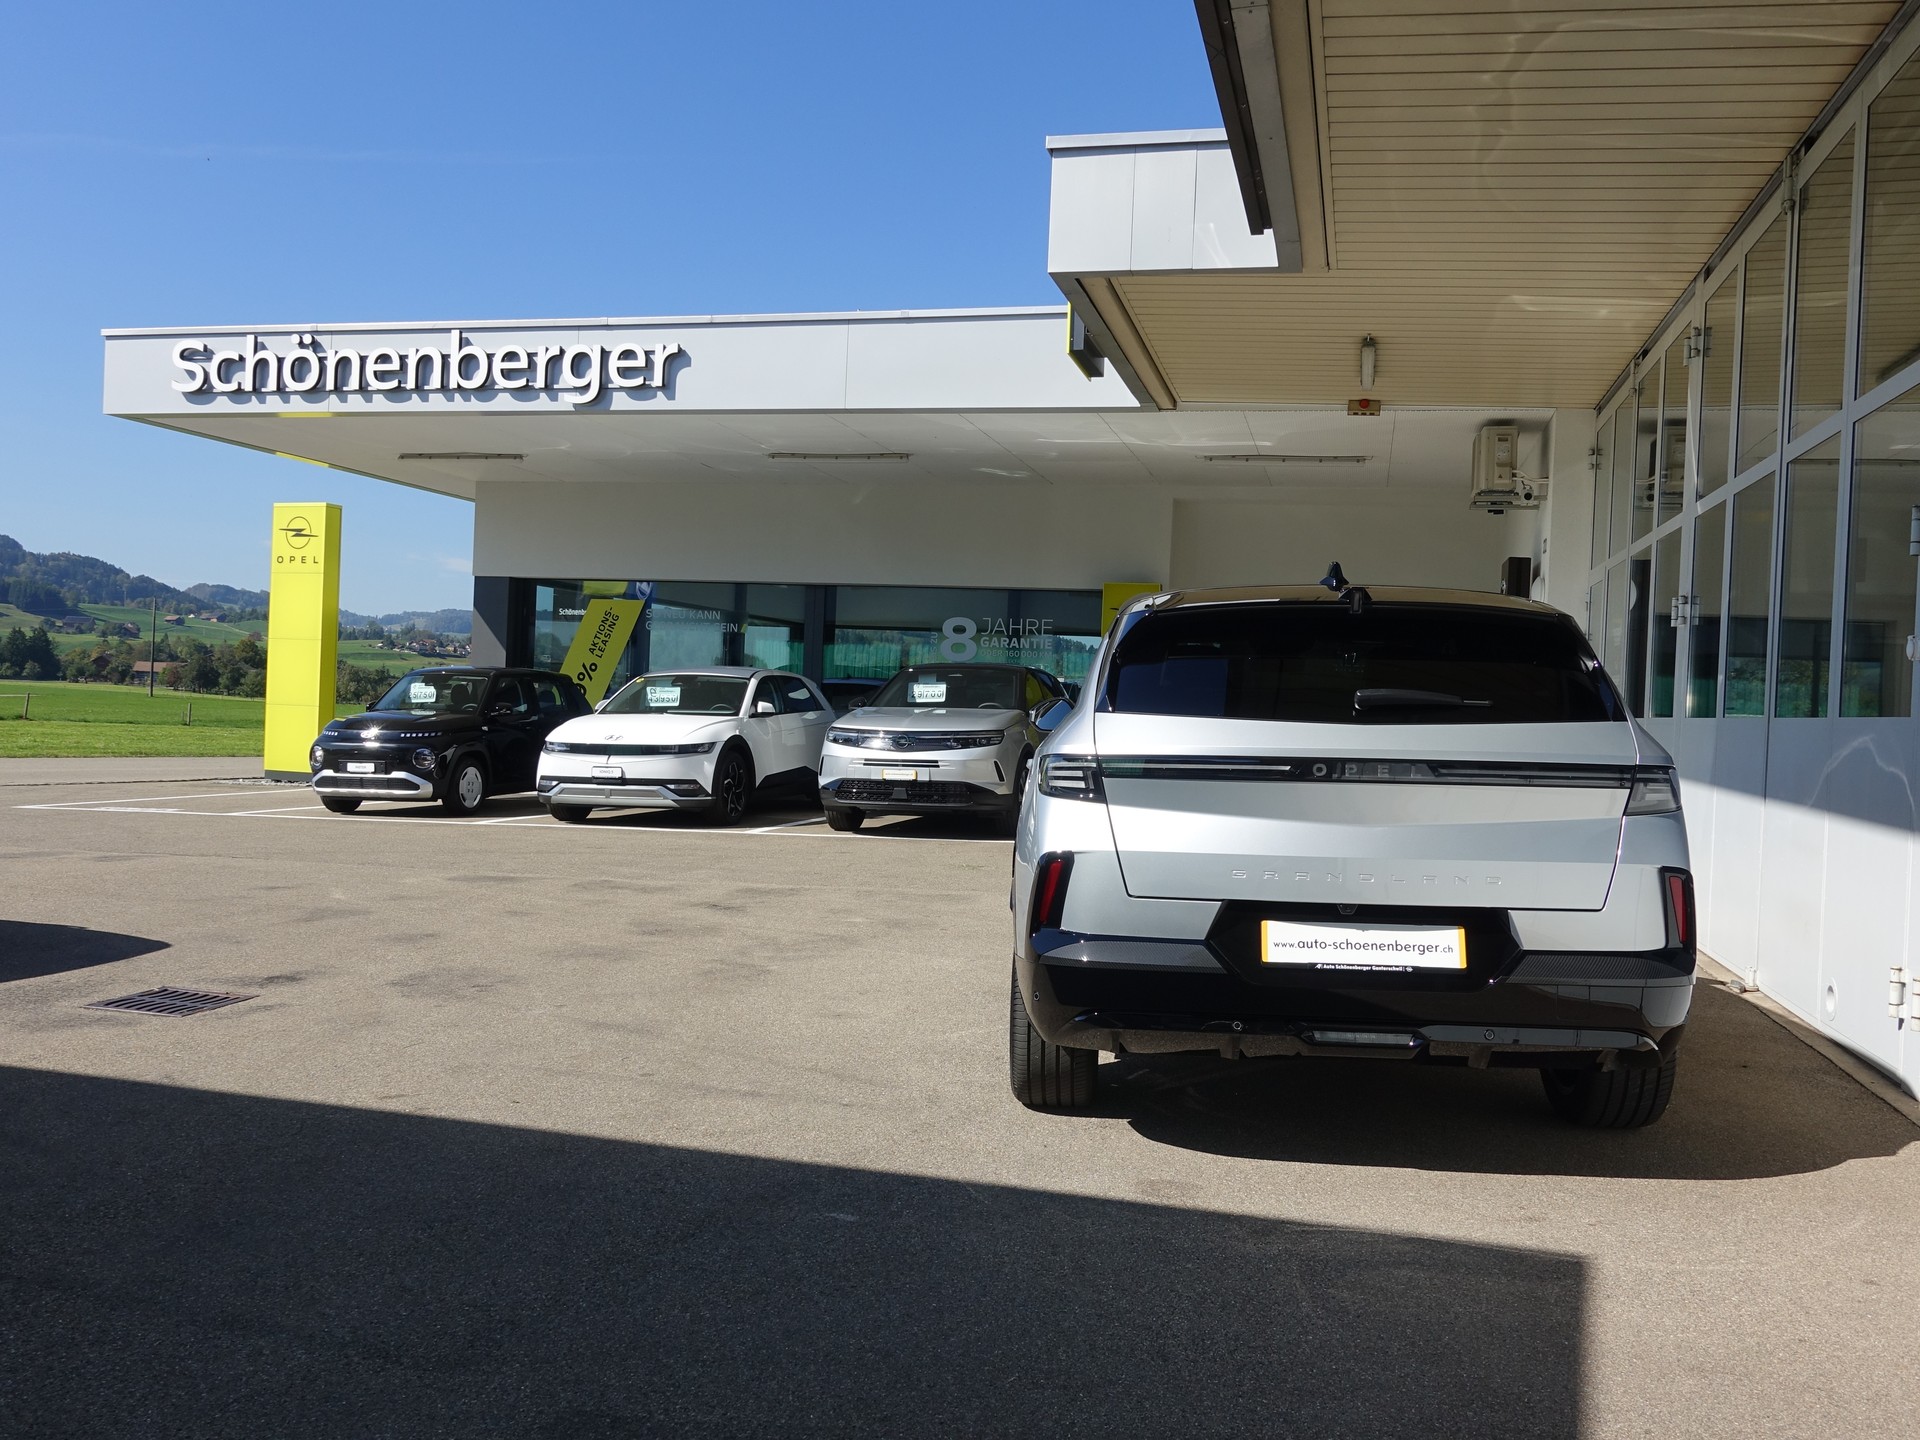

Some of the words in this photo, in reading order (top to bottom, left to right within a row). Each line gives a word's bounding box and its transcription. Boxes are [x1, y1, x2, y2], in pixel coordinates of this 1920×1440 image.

[171, 329, 681, 404] Schönenberger
[276, 555, 319, 564] OPEL
[689, 610, 721, 620] KANN
[588, 607, 613, 655] AKTIONS-
[980, 617, 1054, 636] JAHRE
[595, 613, 620, 659] LEASING
[941, 616, 978, 662] 8
[980, 636, 1053, 650] GARANTIE
[1312, 763, 1422, 779] OPEL
[1231, 869, 1502, 886] GRANDLAND
[1272, 938, 1454, 956] www.auto-schoenenberger.ch
